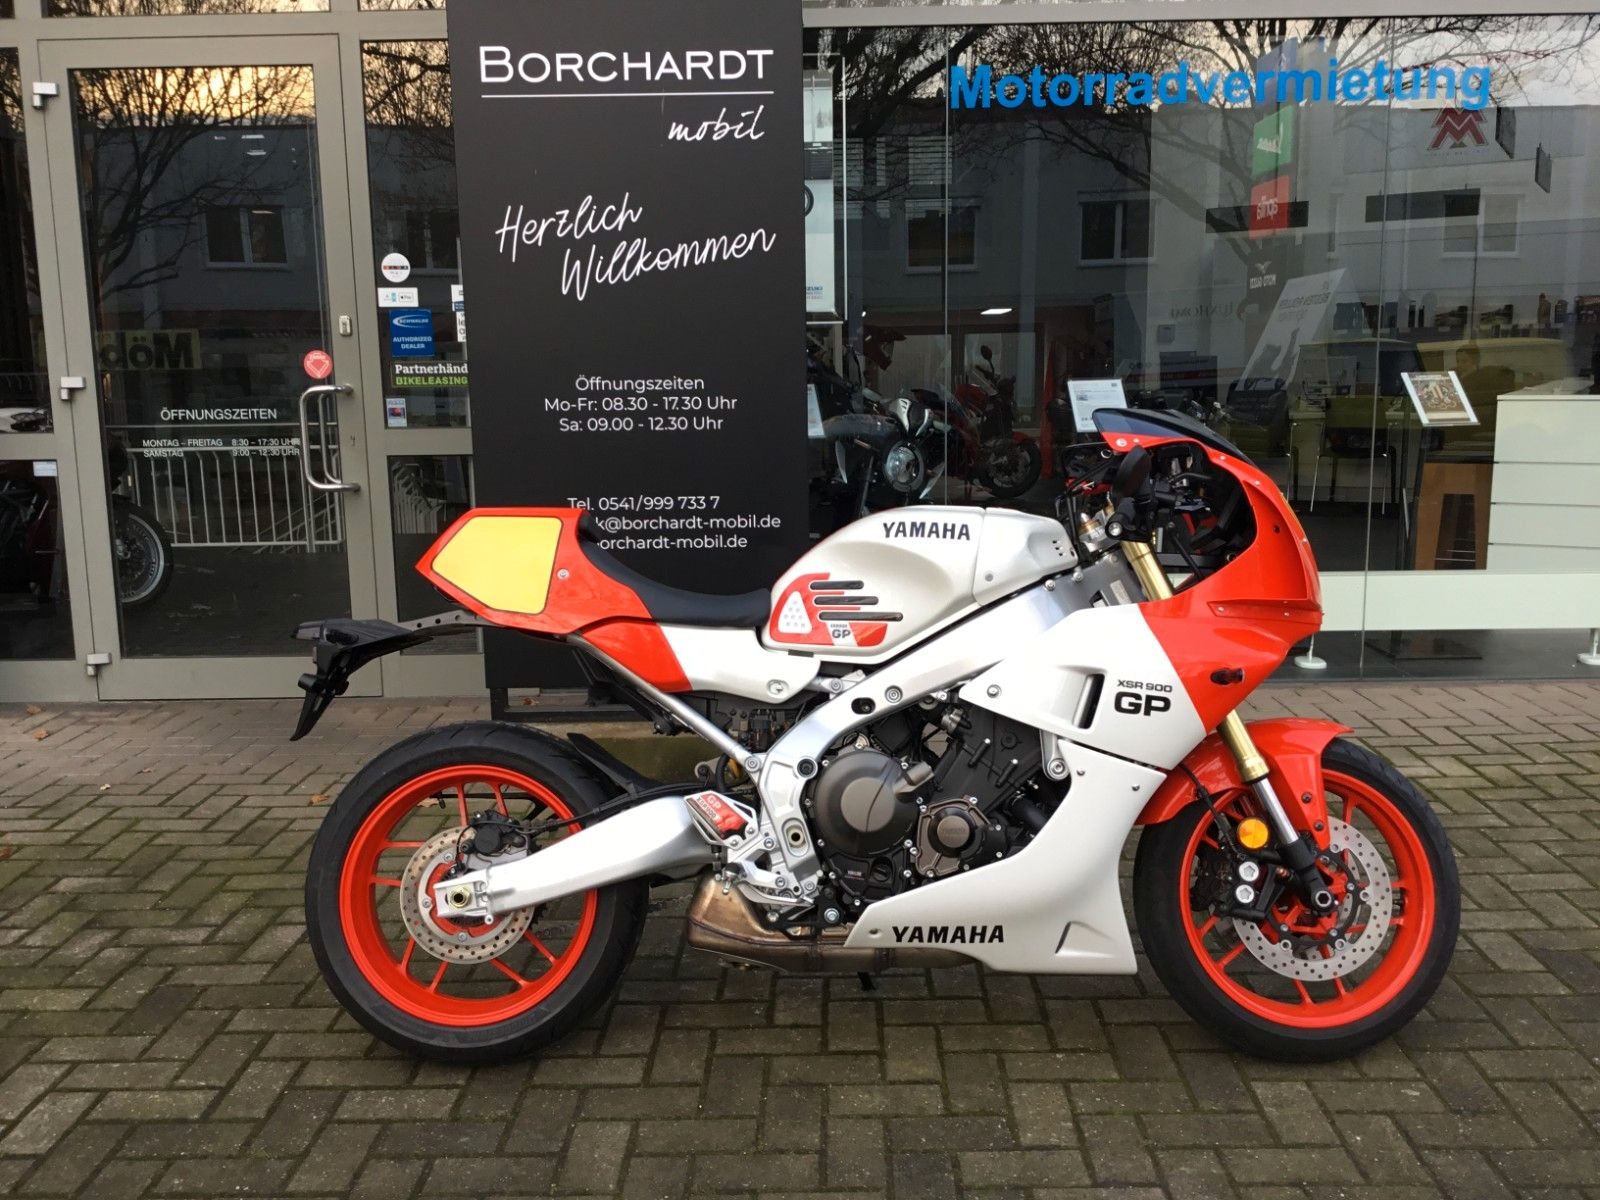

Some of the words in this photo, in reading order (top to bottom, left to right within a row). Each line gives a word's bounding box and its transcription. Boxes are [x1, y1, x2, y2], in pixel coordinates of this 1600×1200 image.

[949, 58, 1491, 111] Motorradvermietung
[667, 104, 765, 142] mobil
[495, 191, 643, 263] Herzlich
[561, 228, 777, 301] Willkommen
[392, 335, 433, 343] AUTHORIZED
[575, 373, 705, 394] Öffnungszeiten
[544, 397, 598, 412] Mo-Fr:
[602, 396, 648, 412] 08.30
[662, 395, 703, 411] 17.30
[707, 395, 738, 410] Uhr
[160, 406, 278, 421] ÖFFNUNGSZEITEN
[559, 417, 584, 432] Sa:
[587, 416, 634, 432] 09.00
[647, 416, 689, 431] 12.30
[693, 415, 724, 431] Uhr
[142, 439, 180, 448] MONTAG
[187, 438, 223, 448] FREITAG
[231, 438, 249, 447] 8:30
[258, 438, 280, 447] 17:30
[143, 449, 184, 458] SAMSTAG
[232, 449, 250, 457] 9:00
[259, 449, 280, 457] 12:30
[281, 448, 300, 457] UHR
[567, 497, 595, 511] Tel.
[598, 494, 675, 512] 0541/999
[677, 495, 707, 510] 733
[709, 495, 720, 509] 7
[882, 521, 971, 541] YAMAHA
[597, 533, 748, 550] orchardt-mobil.de
[831, 628, 851, 639] GP
[1117, 680, 1144, 690] XSR
[1145, 683, 1173, 693] 900
[1114, 691, 1171, 717] GP
[891, 924, 1004, 943] YAMAHA
